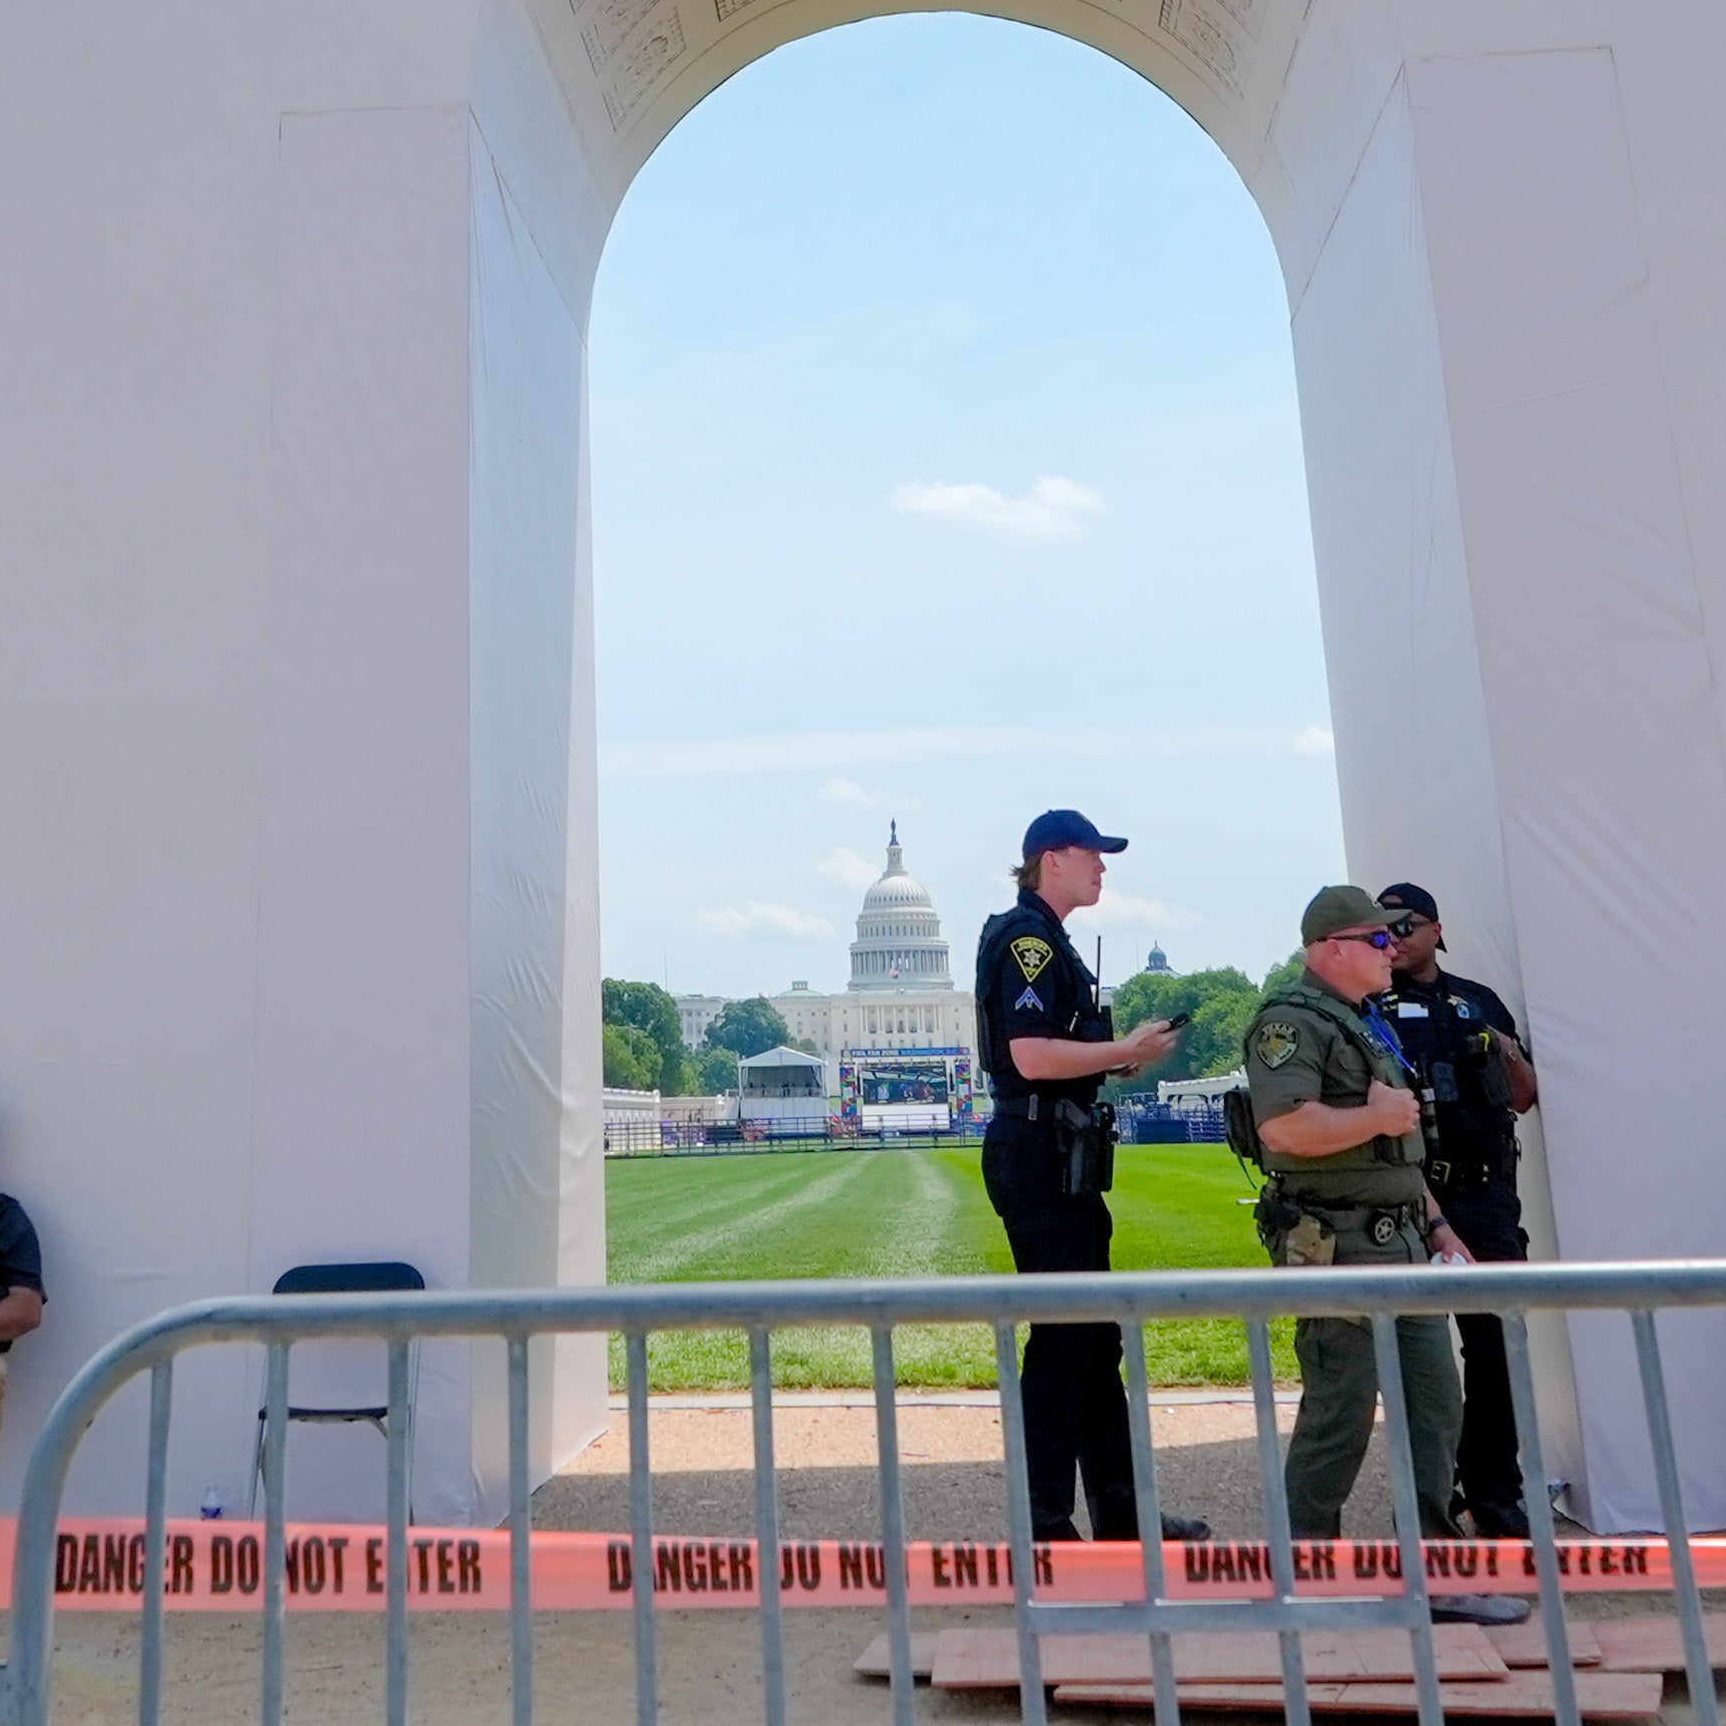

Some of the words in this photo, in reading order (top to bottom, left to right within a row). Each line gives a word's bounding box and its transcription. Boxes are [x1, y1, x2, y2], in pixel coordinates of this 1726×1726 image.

[55, 1533, 193, 1594] DANGR
[210, 1535, 259, 1595] DO
[366, 1537, 482, 1594] ETER
[607, 1540, 753, 1592] DNGER
[839, 1544, 909, 1590] NO
[932, 1546, 1053, 1587] ENTR
[1185, 1544, 1336, 1582] DANER
